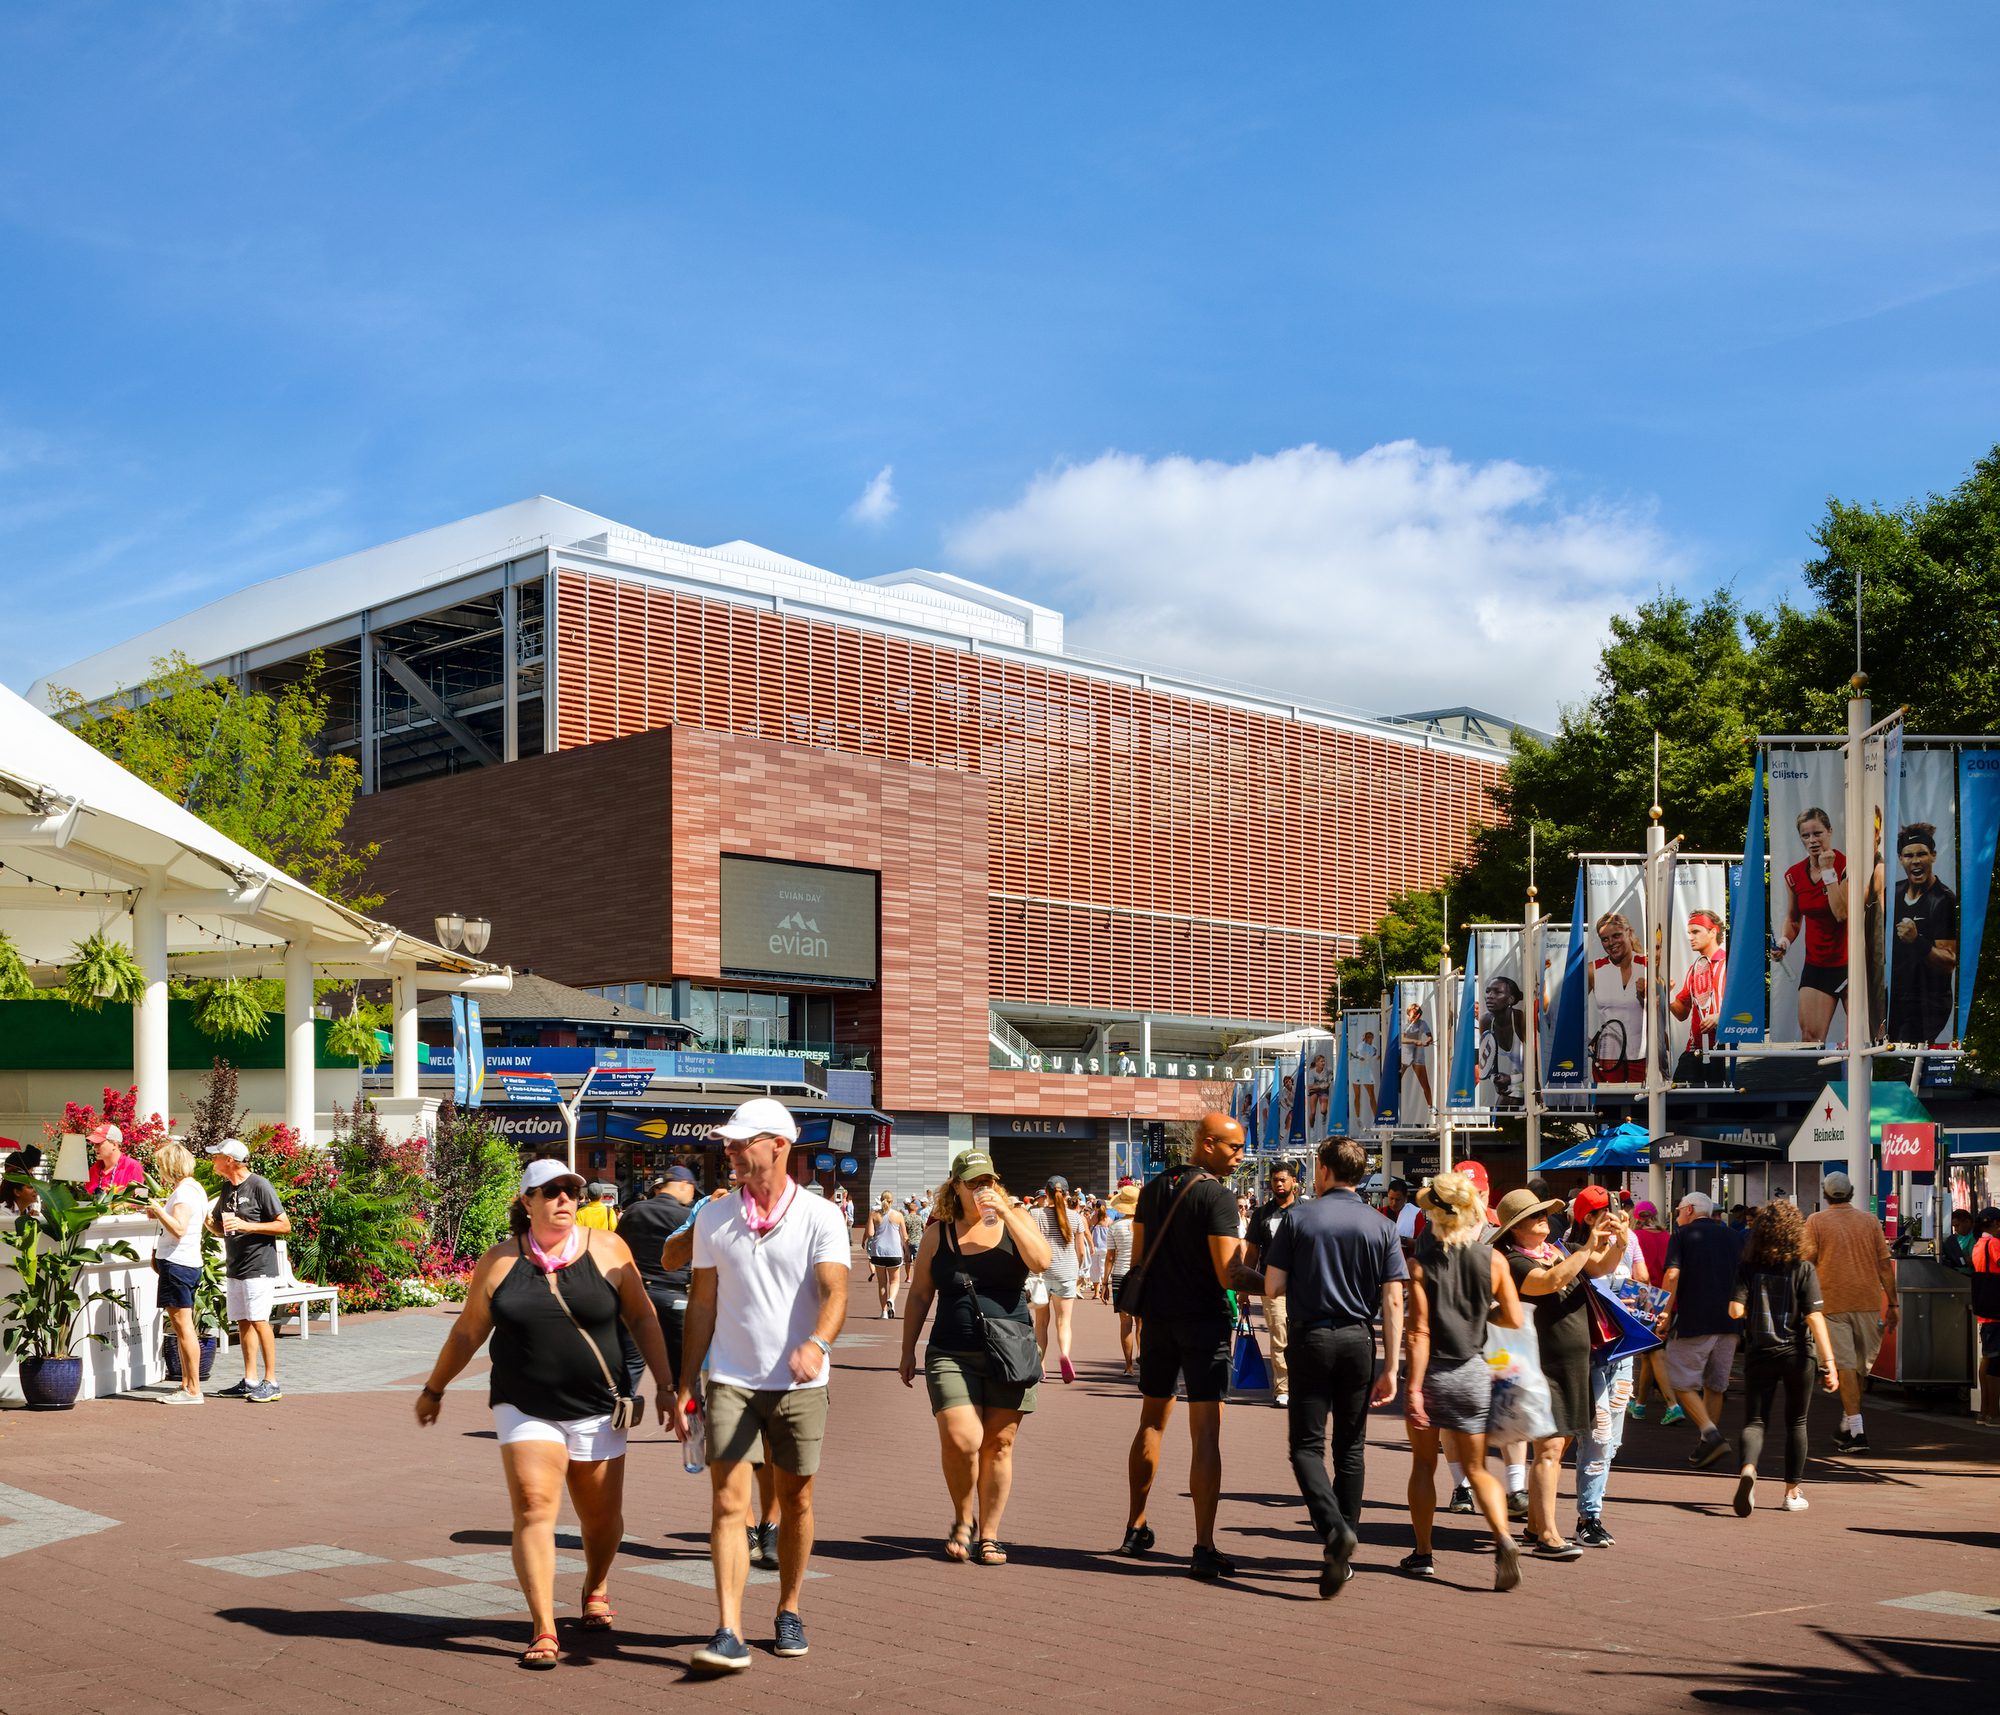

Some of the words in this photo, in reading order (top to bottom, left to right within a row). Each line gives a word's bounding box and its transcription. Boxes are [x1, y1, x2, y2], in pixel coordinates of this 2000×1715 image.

[1771, 760, 1789, 769] Kim
[1967, 759, 2000, 770] 2010
[1772, 770, 1809, 780] Clijsters
[1589, 879, 1618, 887] Clijsters
[779, 890, 804, 901] EVIAN
[805, 894, 821, 903] DAY
[769, 931, 828, 958] evian
[1724, 1026, 1735, 1034] us
[1736, 1026, 1759, 1036] open
[736, 1046, 786, 1058] AMERICAN
[787, 1049, 830, 1061] EXPRESS
[486, 1056, 513, 1067] EVIAN
[515, 1056, 532, 1067] DAY
[678, 1055, 684, 1063] J.
[685, 1056, 706, 1065] Murray
[677, 1065, 684, 1073] B.
[685, 1065, 705, 1074] Soares
[1564, 1070, 1579, 1079] open
[487, 1116, 563, 1134] llection
[1011, 1120, 1051, 1133] GATE
[1057, 1121, 1067, 1134] A
[671, 1123, 690, 1136] us
[691, 1124, 722, 1141] ope
[1718, 1128, 1777, 1146] LAVAZZA
[1813, 1128, 1845, 1142] Heineken
